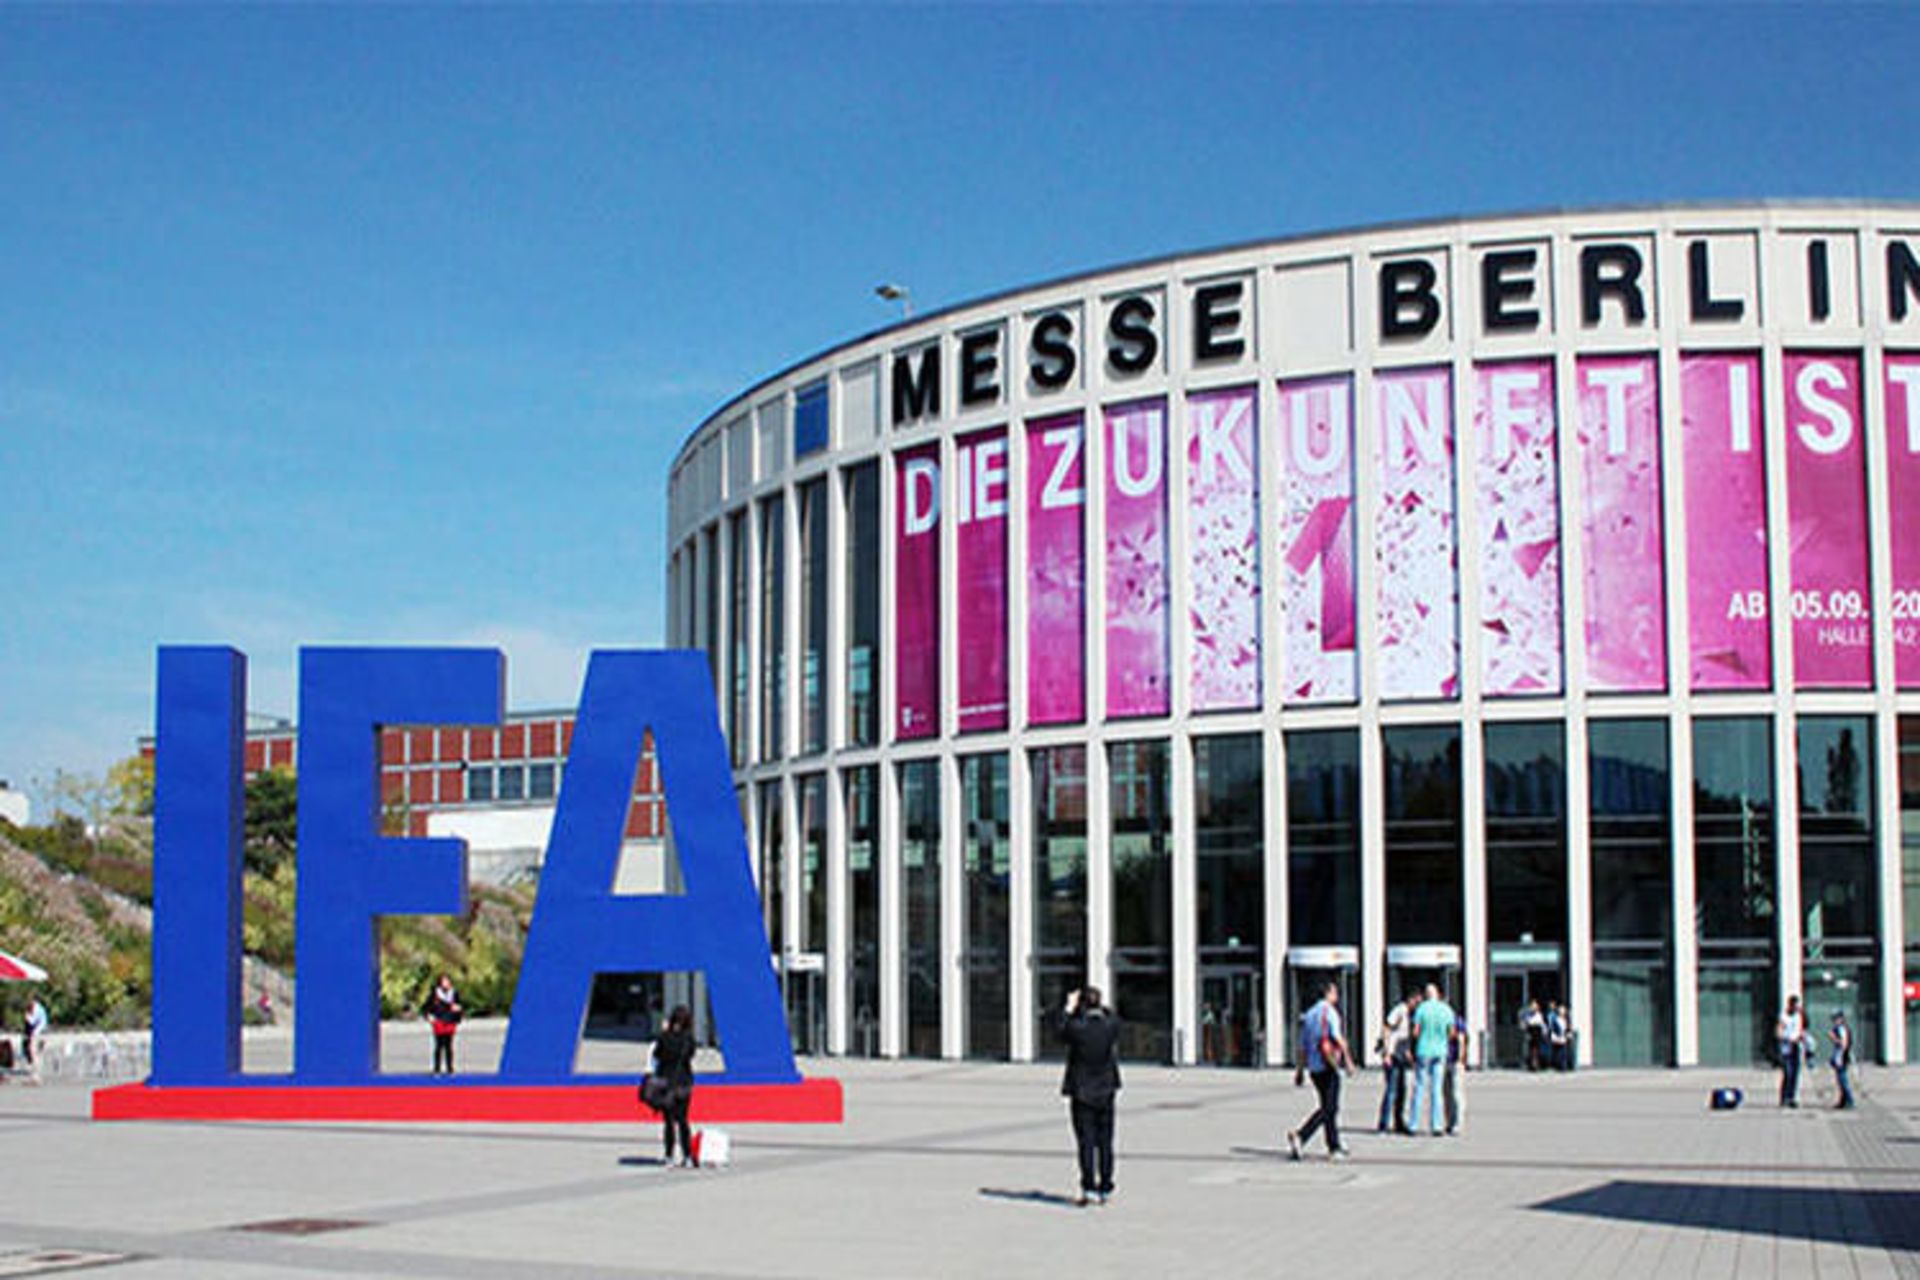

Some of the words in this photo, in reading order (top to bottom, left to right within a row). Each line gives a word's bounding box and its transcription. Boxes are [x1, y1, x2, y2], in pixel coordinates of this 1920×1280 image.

[893, 281, 1246, 427] MESSE
[1379, 239, 1920, 341] BERLIN
[904, 438, 1009, 535] DIE
[1041, 366, 1644, 509] ZUKUNFT
[1727, 590, 1766, 620] AB
[1790, 589, 1869, 620] 05.09.
[152, 644, 801, 1085] IFA
